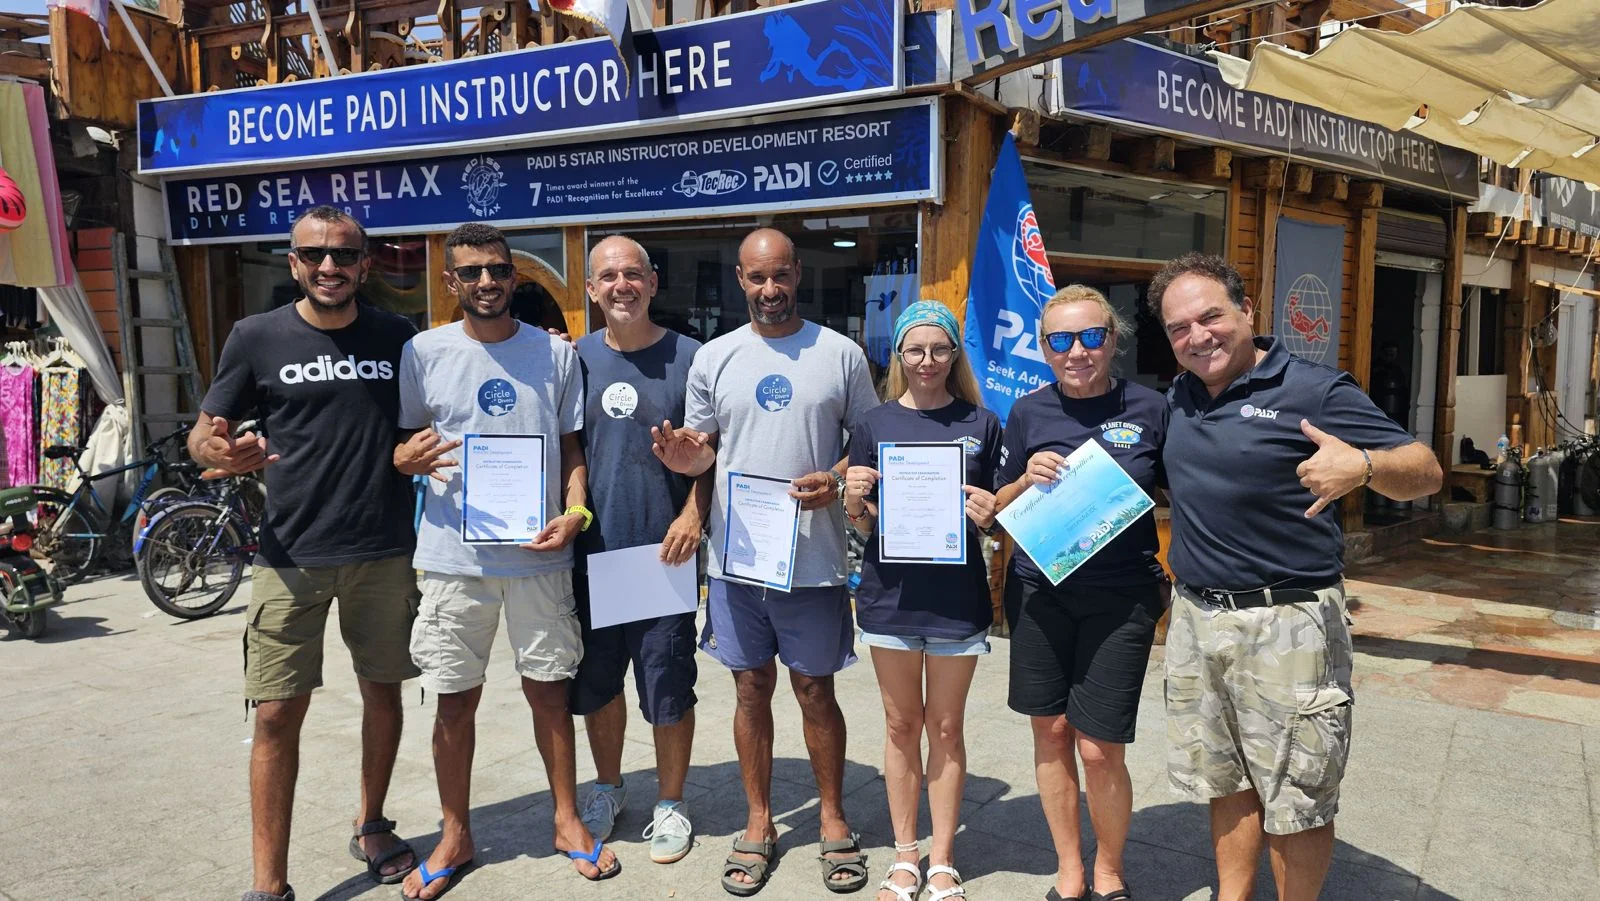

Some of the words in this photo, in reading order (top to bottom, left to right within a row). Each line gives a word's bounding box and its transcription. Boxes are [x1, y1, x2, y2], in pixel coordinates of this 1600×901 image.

[228, 98, 334, 146] BECOME
[346, 88, 407, 133] PADI
[420, 59, 621, 126] INSTRUCTOR
[638, 40, 732, 98] HERE
[1157, 69, 1246, 128] BECOME
[1253, 95, 1294, 140] PADI
[1300, 108, 1397, 165] INSTRUCTOR
[1401, 136, 1435, 174] HERE
[526, 154, 557, 170] PADI
[559, 154, 567, 168] 5
[569, 150, 605, 167] STAR
[608, 141, 699, 163] INSTRUCTOR
[702, 129, 818, 155] DEVELOPMENT
[822, 120, 892, 143] RESORT
[844, 154, 892, 170] Certified
[546, 183, 565, 192] Times
[567, 180, 588, 190] award
[590, 179, 615, 188] winners
[618, 177, 625, 186] of
[627, 177, 639, 185] the
[701, 173, 739, 191] TecRec
[753, 161, 811, 192] PADI
[186, 182, 243, 213] RED
[258, 177, 315, 209] SEA
[331, 164, 442, 203] RELAX
[529, 182, 542, 207] 7
[547, 195, 564, 204] PADI
[612, 191, 622, 199] for
[190, 213, 247, 230] DIVE
[270, 204, 371, 225] RERT
[279, 355, 394, 384] adidas
[987, 360, 1015, 380] Seek
[484, 390, 511, 400] Circle
[762, 385, 787, 395] Circle
[985, 377, 1012, 396] Save
[608, 392, 633, 401] Circle
[1254, 407, 1280, 420] PADI
[1100, 421, 1123, 431] PLANET
[1122, 422, 1144, 434] DIVERS
[1090, 520, 1115, 543] PADI
